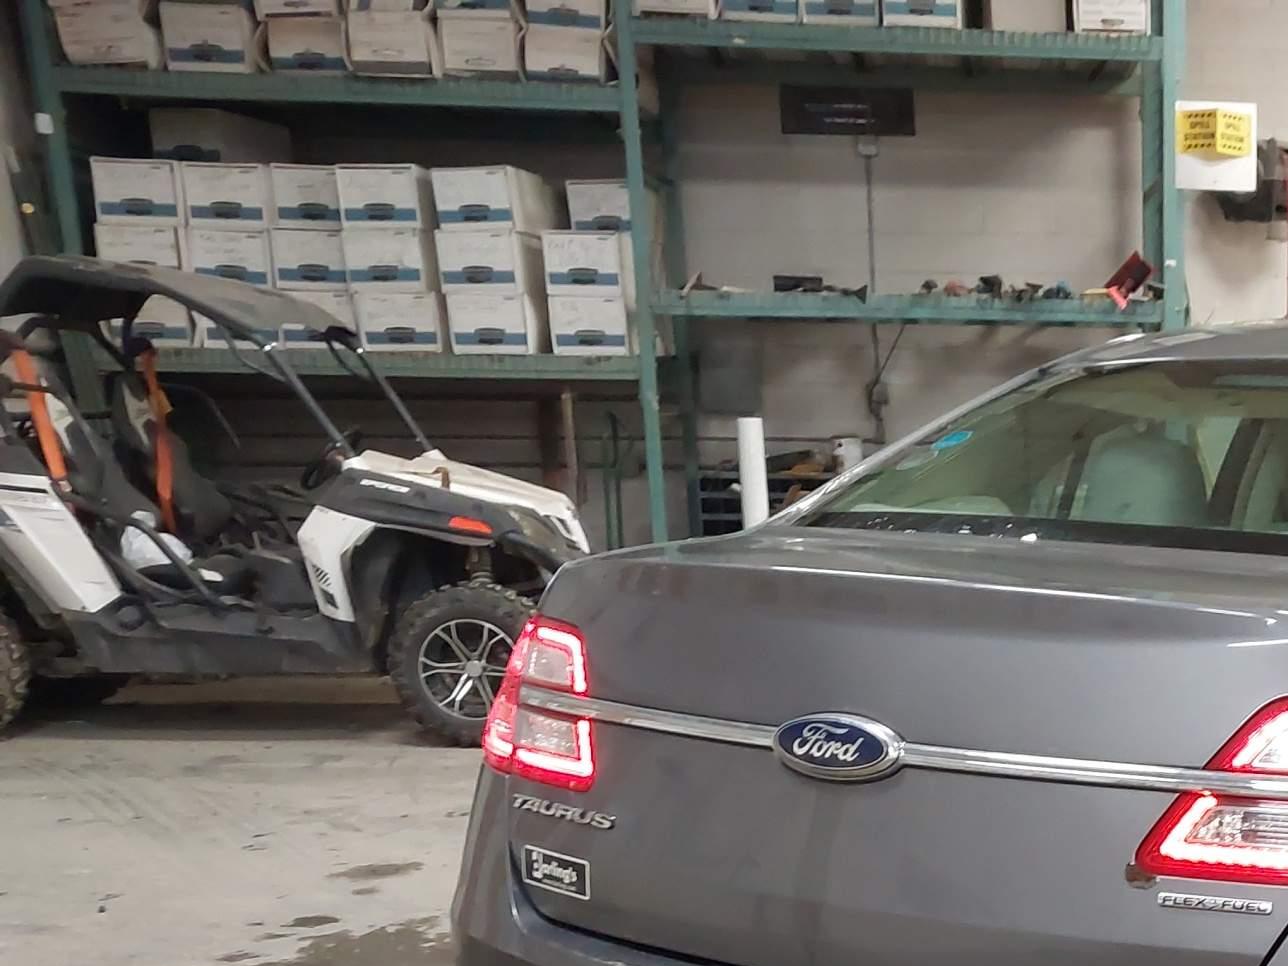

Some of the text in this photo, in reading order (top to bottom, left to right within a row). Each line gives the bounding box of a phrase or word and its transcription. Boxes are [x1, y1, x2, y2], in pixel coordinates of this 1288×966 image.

[792, 722, 865, 762] Ford
[511, 792, 617, 830] TAURUS
[1161, 894, 1269, 913] FLEX FUEL
